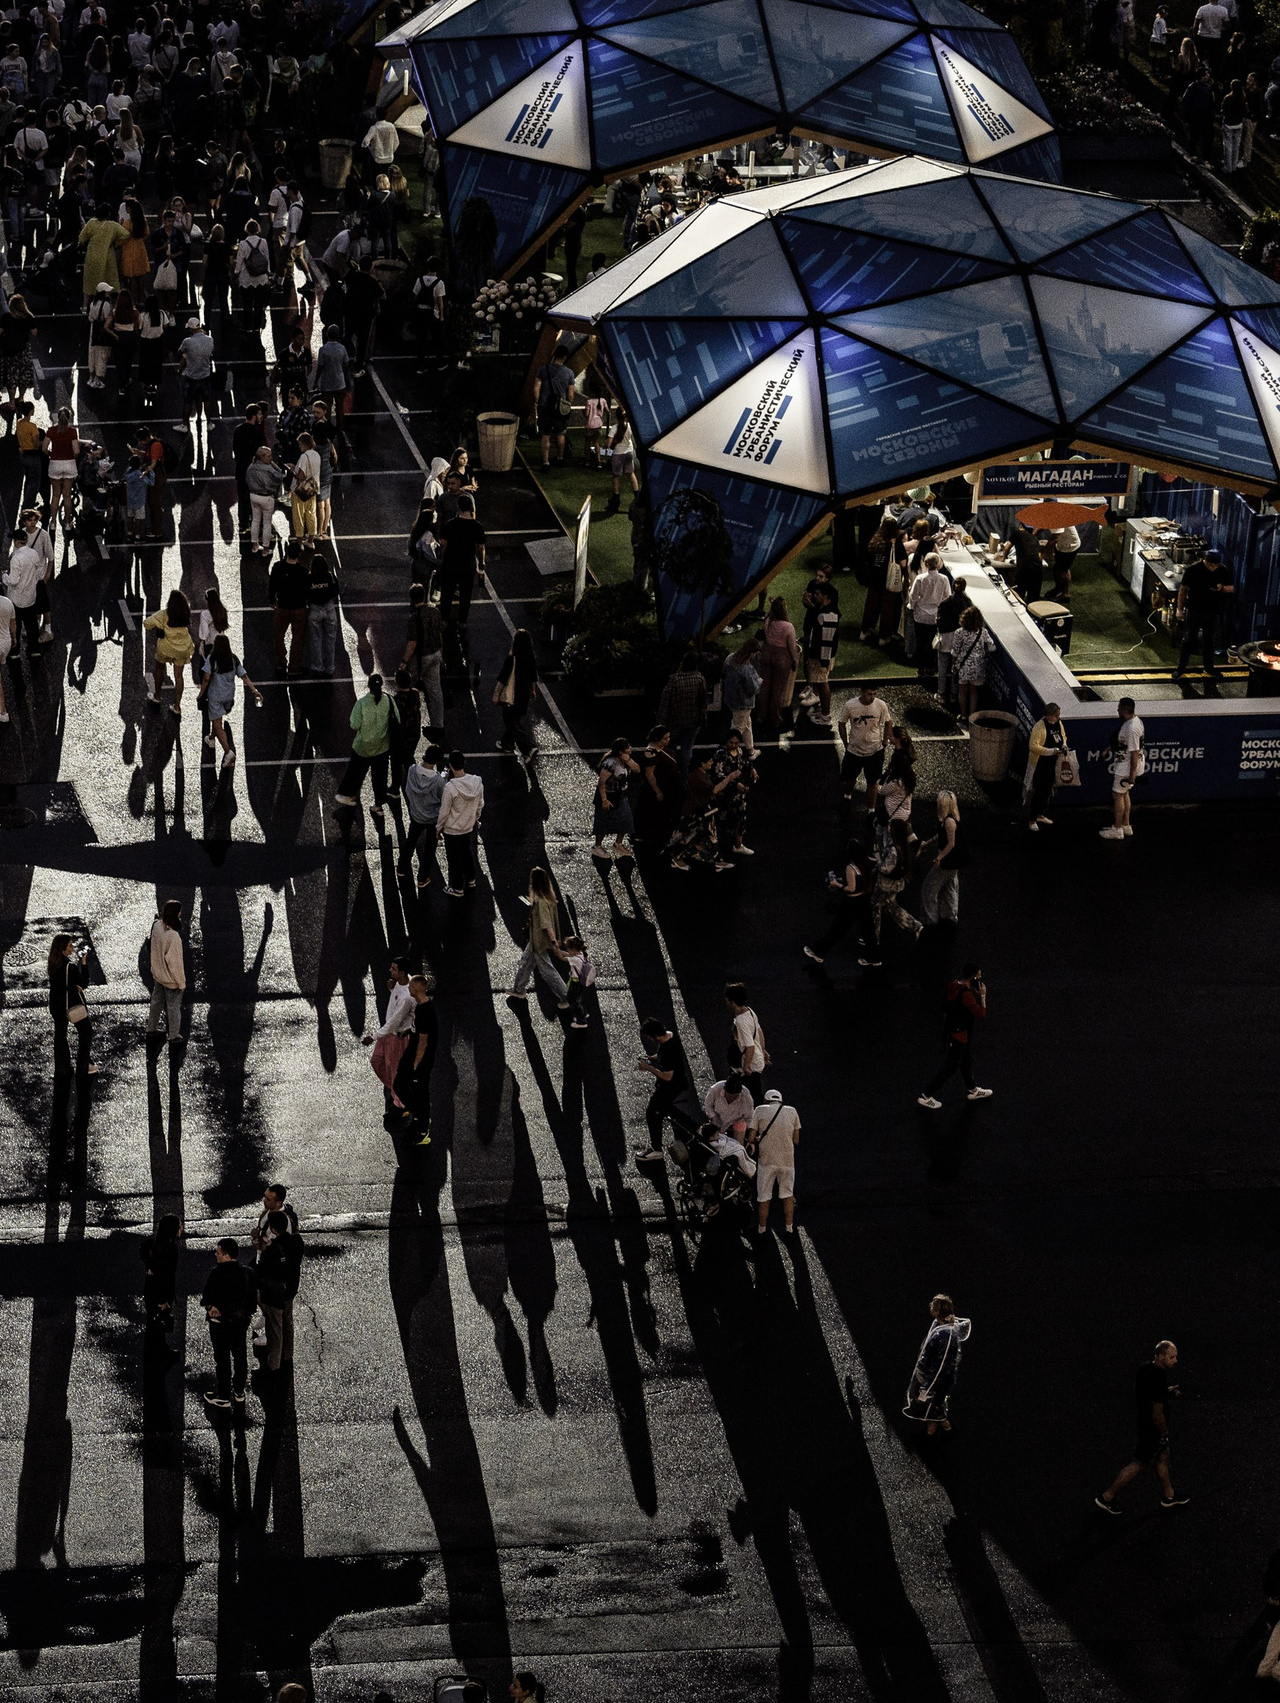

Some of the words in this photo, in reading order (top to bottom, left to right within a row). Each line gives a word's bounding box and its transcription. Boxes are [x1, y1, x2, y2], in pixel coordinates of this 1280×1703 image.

[513, 82, 551, 143] МОСКОВСКИЙ
[521, 56, 573, 145] УРБАНИСТИЧЕСКИЙ
[530, 114, 552, 147] ФОРУМ
[733, 380, 777, 457] МОСКОВСКИЙ
[743, 349, 804, 460] УРБАНИСТИЧЕСКИЙ
[754, 421, 780, 462] ФОРУМ
[852, 416, 979, 461] МОСКОВСКИЕ
[882, 434, 960, 465] СЕЗОНЫ
[1017, 469, 1094, 484] МАГАДАН
[1239, 760, 1280, 770] ФОРУМ
[1241, 750, 1280, 759] УРБАН
